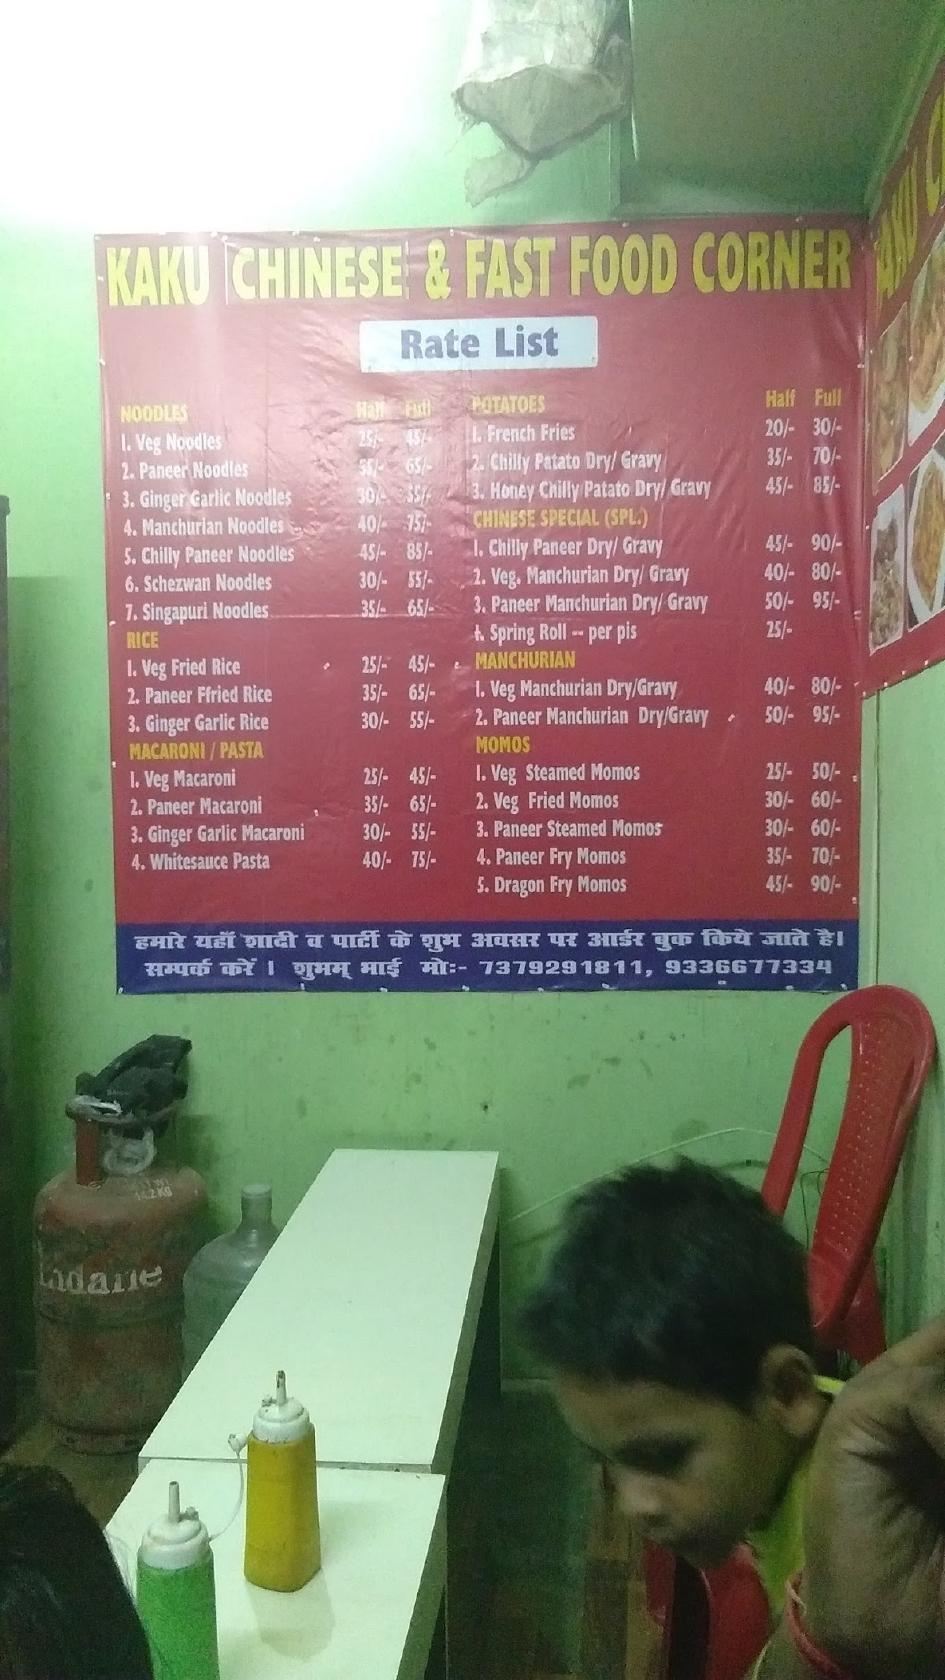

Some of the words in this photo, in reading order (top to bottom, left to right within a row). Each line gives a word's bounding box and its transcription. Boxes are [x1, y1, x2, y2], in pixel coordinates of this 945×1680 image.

[107, 246, 209, 306] KAKU
[232, 246, 403, 300] CHINESE
[425, 239, 451, 299] &
[466, 238, 556, 298] FAST
[571, 234, 677, 296] FOOD
[693, 229, 850, 293] CORNER
[400, 330, 480, 360] Rate
[496, 326, 559, 357] List
[472, 395, 545, 413] POTATOES
[766, 389, 795, 407] Half
[815, 388, 841, 406] Full
[121, 404, 188, 423] NOODLES
[488, 425, 535, 442] French
[541, 423, 576, 441] Fries
[765, 418, 794, 438] 20/-
[813, 417, 842, 437] 30/-
[136, 434, 161, 455] Veg
[167, 433, 222, 450] Noodles
[139, 462, 188, 480] Paneer
[193, 461, 248, 478] Noodles
[491, 453, 530, 474] Chilly
[586, 450, 617, 474] Dry/
[621, 450, 662, 472] Gravy
[767, 447, 792, 467] 35/-
[813, 447, 841, 466] 70/-
[140, 490, 186, 512] Ginger
[190, 489, 230, 507] Garlic
[235, 488, 292, 507] Noodles
[491, 482, 534, 502] Honey
[539, 480, 579, 502] Chilly
[636, 479, 667, 501] Dry/
[671, 478, 711, 500] Gravy
[142, 519, 223, 536] Manchurian
[228, 517, 284, 534] Noodles
[474, 509, 535, 528] CHINESE
[541, 508, 599, 527] SPECIAL
[605, 507, 649, 528] (SPL.)
[142, 547, 180, 569] Chilly
[186, 547, 233, 563] Paneer
[239, 546, 295, 562] Noodles
[489, 539, 528, 560] Chilly
[534, 539, 582, 556] Paneer
[587, 536, 618, 559] Dry/
[623, 536, 663, 558] Gravy
[766, 534, 792, 554] 45/-
[811, 533, 842, 554] 90/-
[144, 576, 211, 592] Schezwan
[216, 574, 272, 591] Noodles
[491, 568, 521, 589] Veg.
[527, 566, 608, 585] Manchurian
[614, 565, 644, 587] Dry/
[650, 564, 689, 586] Gravy
[765, 563, 794, 582] 40/-
[812, 562, 841, 582] 80/-
[143, 602, 208, 625] Singapuri
[213, 602, 269, 619] Noodles
[492, 595, 540, 613] Paneer
[546, 593, 627, 612] Manchurian
[632, 593, 662, 615] Dry/
[668, 592, 708, 614] Gravy
[765, 592, 794, 611] 50/-
[813, 591, 840, 611] 95/-
[127, 631, 159, 648] RICE
[490, 623, 535, 646] Spring
[539, 623, 567, 640] Roll
[589, 626, 612, 645] per
[617, 621, 637, 644] pis
[767, 620, 792, 640] 25/-
[142, 659, 167, 681] Veg
[172, 658, 206, 676] Fried
[212, 658, 241, 675] Rice
[476, 651, 576, 669] MANCHURIAN
[145, 687, 192, 704] Paneer
[243, 685, 272, 703] Rice
[491, 680, 516, 702] Veg
[520, 678, 602, 697] Manchurian
[607, 678, 677, 700] Dry/Gravy
[765, 677, 795, 696] 40/-
[811, 676, 842, 696] 80/-
[145, 714, 190, 736] Ginger
[195, 713, 235, 731] Garlic
[240, 713, 269, 730] Rice
[494, 709, 542, 725] Paneer
[547, 706, 629, 725] Manchurian
[639, 706, 709, 728] Dry/Gravy
[765, 706, 794, 725] 50/-
[813, 706, 840, 725] 95/-
[129, 743, 205, 759] MACARONI
[220, 742, 264, 759] PASTA
[476, 735, 530, 753] MOMOS
[144, 771, 169, 792] Veg
[174, 769, 236, 787] Macaroni
[491, 764, 516, 786] Veg
[526, 763, 585, 781] Steamed
[591, 763, 640, 781] Momos
[766, 762, 792, 781] 25/-
[812, 762, 840, 781] 50/-
[148, 799, 195, 815] Paneer
[200, 796, 262, 814] Macaroni
[493, 792, 519, 814] Veg
[528, 792, 565, 809] Fried
[569, 791, 619, 808] Momos
[765, 791, 794, 810] 30/-
[811, 791, 842, 810] 60/-
[148, 825, 192, 847] Ginger
[198, 824, 237, 842] Garlic
[242, 824, 305, 841] Macaroni
[494, 821, 543, 837] Paneer
[547, 820, 606, 837] Steamed
[612, 820, 662, 837] Momos
[765, 818, 794, 838] 30/-
[811, 818, 841, 837] 60/-
[150, 853, 228, 870] Whitesauce
[233, 852, 270, 869] Pasta
[496, 849, 544, 865] Paneer
[550, 848, 572, 869] Fry
[578, 848, 626, 864] Momos
[767, 847, 792, 866] 35/-
[812, 847, 840, 866] 70/-
[495, 876, 544, 898] Dragon
[551, 876, 572, 897] Fry
[578, 876, 627, 892] Momos
[766, 875, 792, 894] 45/-
[811, 875, 841, 894] 90/-
[134, 931, 187, 949] हमारे
[240, 930, 298, 949] शादी
[305, 934, 324, 949] व
[331, 929, 381, 949] पार्टी
[387, 930, 413, 948] के
[420, 933, 462, 952] शुभ
[472, 932, 541, 948] अवसर
[548, 932, 579, 948] पर
[652, 932, 695, 951] बुक
[701, 928, 753, 947] किये
[760, 928, 810, 947] जाते
[144, 958, 212, 977] सम्पर्क
[220, 958, 257, 976] करें
[479, 959, 653, 977] 7379291811,
[666, 960, 832, 974] 9336677334
